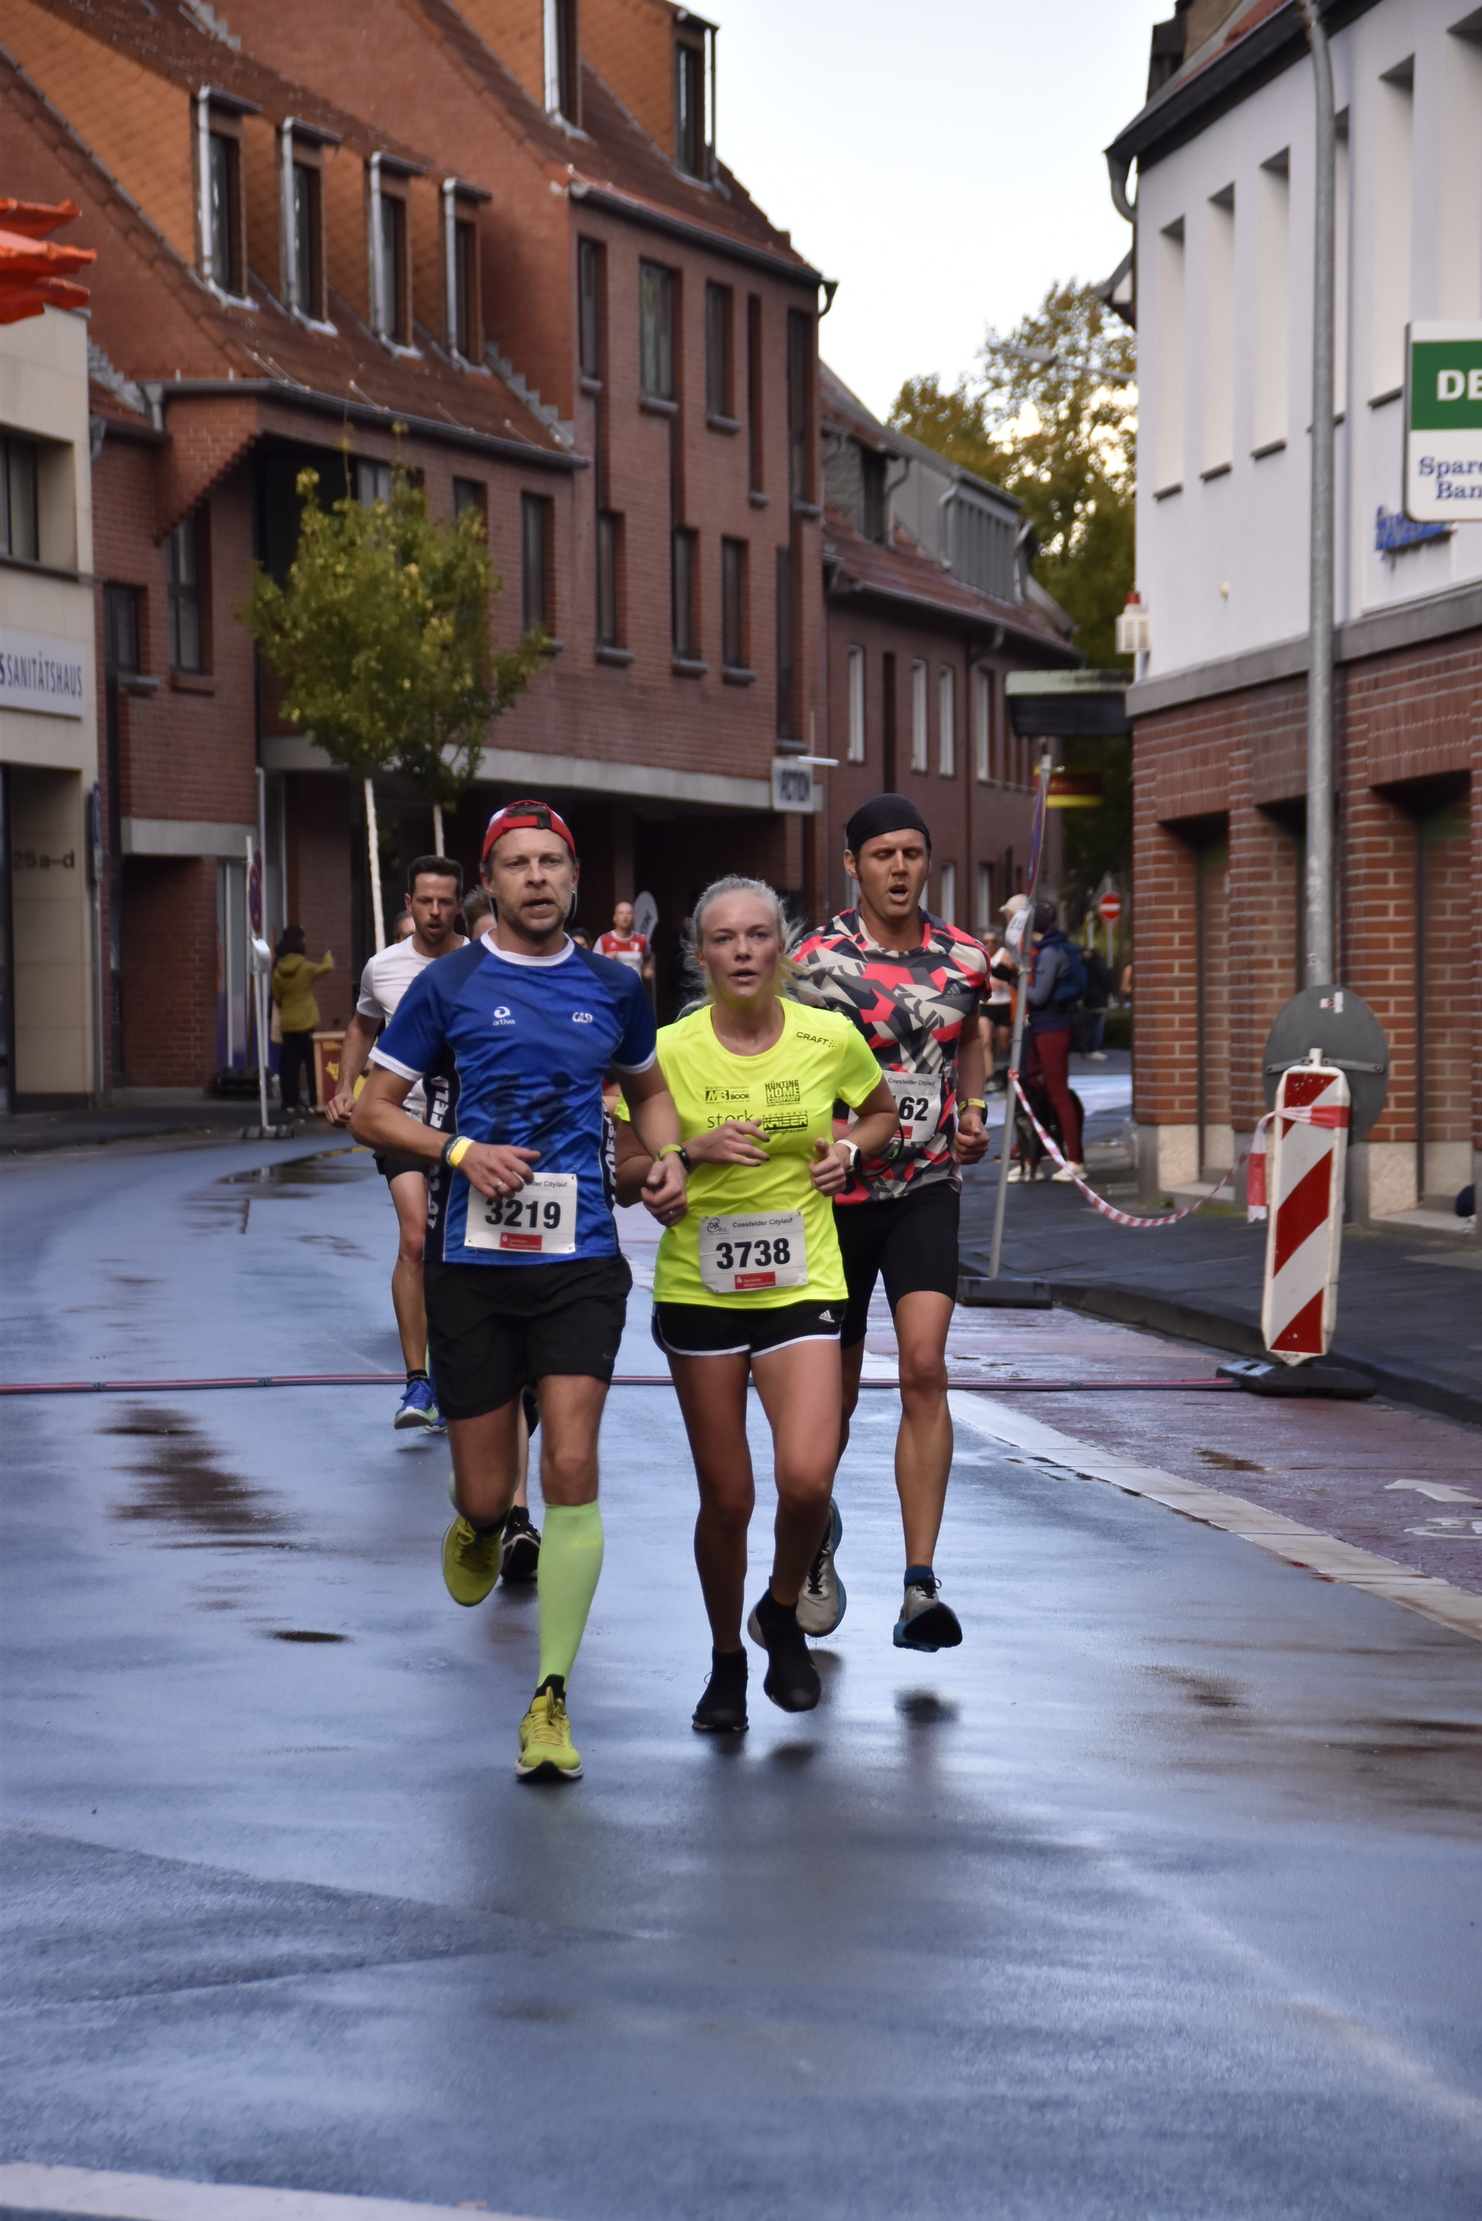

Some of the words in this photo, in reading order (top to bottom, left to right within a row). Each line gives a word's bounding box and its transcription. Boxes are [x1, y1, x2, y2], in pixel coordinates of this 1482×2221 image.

[492, 1018, 515, 1026] artiva
[796, 1031, 829, 1045] CRAFT
[765, 1079, 799, 1090] HÜNTING
[767, 1087, 800, 1098] HOME
[893, 1095, 929, 1121] 62
[485, 1199, 561, 1229] 3219
[769, 1217, 793, 1226] Citylauf
[716, 1237, 791, 1270] 3738
